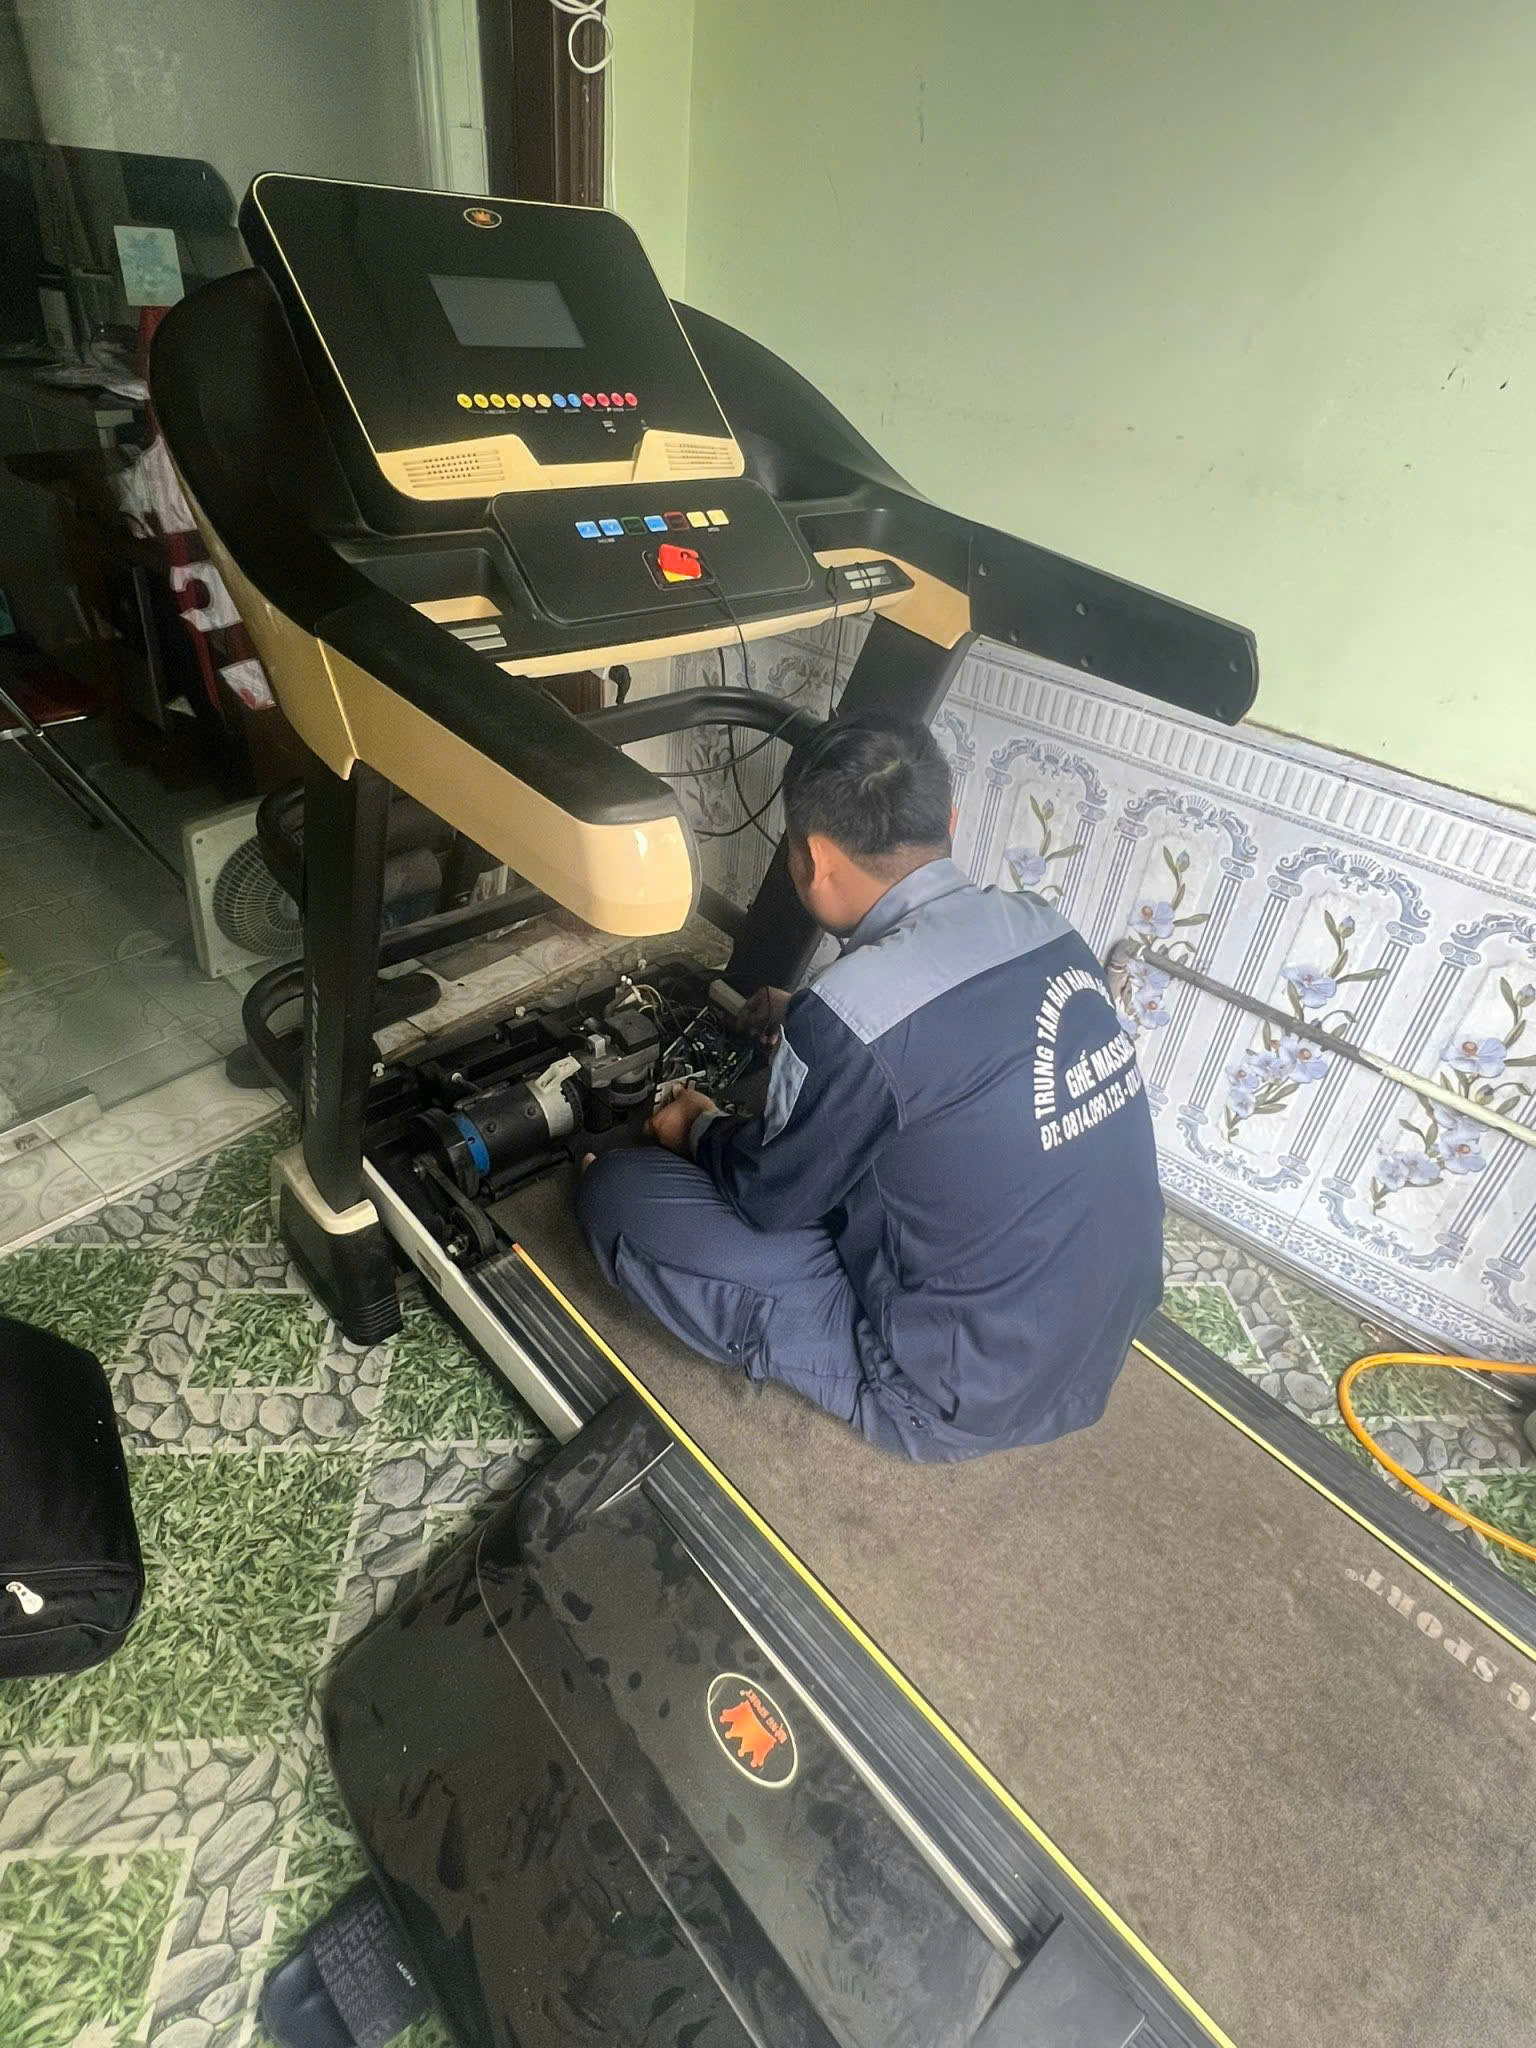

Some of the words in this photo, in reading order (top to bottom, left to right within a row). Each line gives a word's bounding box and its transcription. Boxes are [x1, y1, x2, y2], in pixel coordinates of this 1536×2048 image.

[1046, 976, 1073, 1010] BẢO
[1036, 1000, 1061, 1043] TÂM
[1034, 1045, 1056, 1119] TRUNG
[1065, 1049, 1097, 1099] GHẾ
[1040, 1119, 1063, 1151] ĐT:
[1062, 1082, 1126, 1141] 0814.099.123
